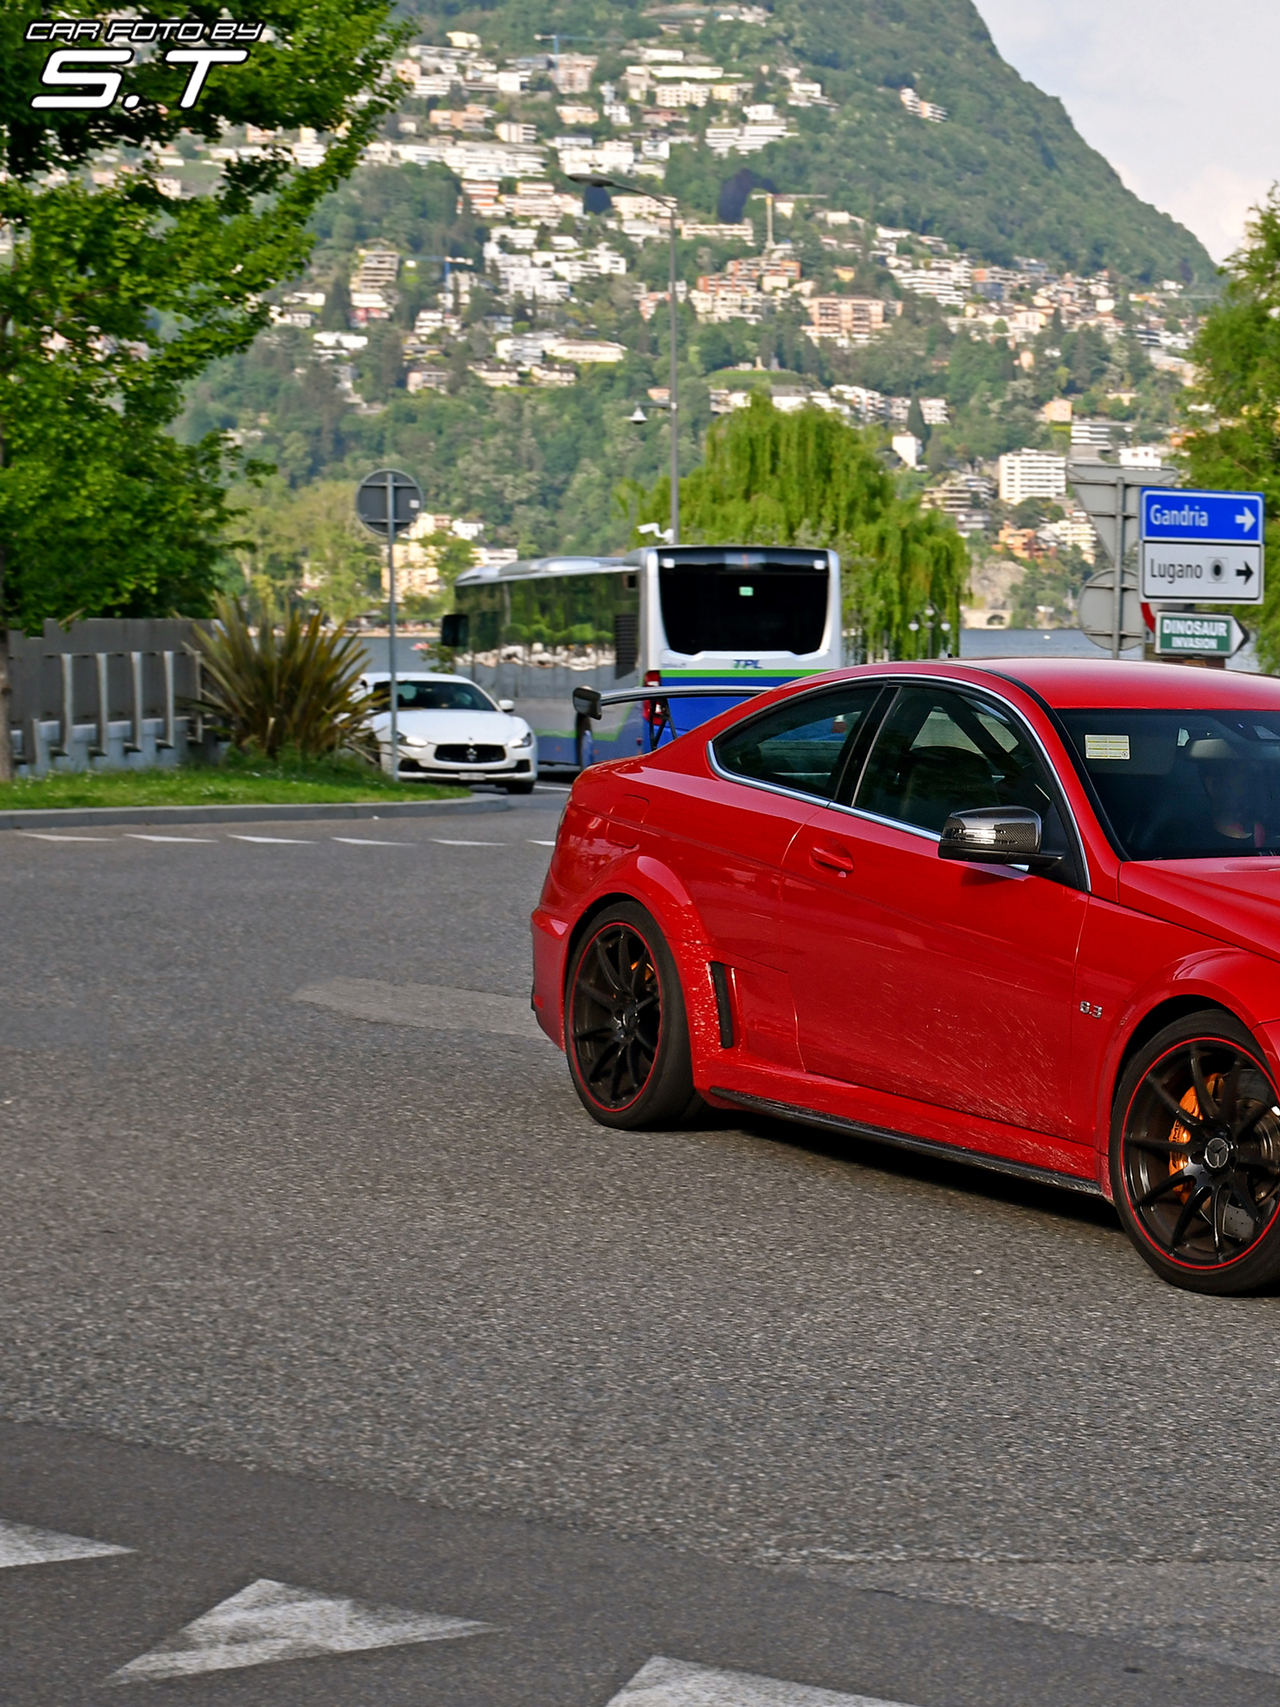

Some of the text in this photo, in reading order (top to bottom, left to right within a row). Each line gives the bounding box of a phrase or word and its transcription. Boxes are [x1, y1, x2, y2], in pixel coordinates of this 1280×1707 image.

[1150, 504, 1209, 527] Gandria
[1150, 558, 1203, 584] Lugano
[1162, 619, 1228, 637] DINOSAUR
[1171, 636, 1218, 649] INVASION
[733, 659, 763, 669] TPL
[1080, 1000, 1103, 1019] 6.3
